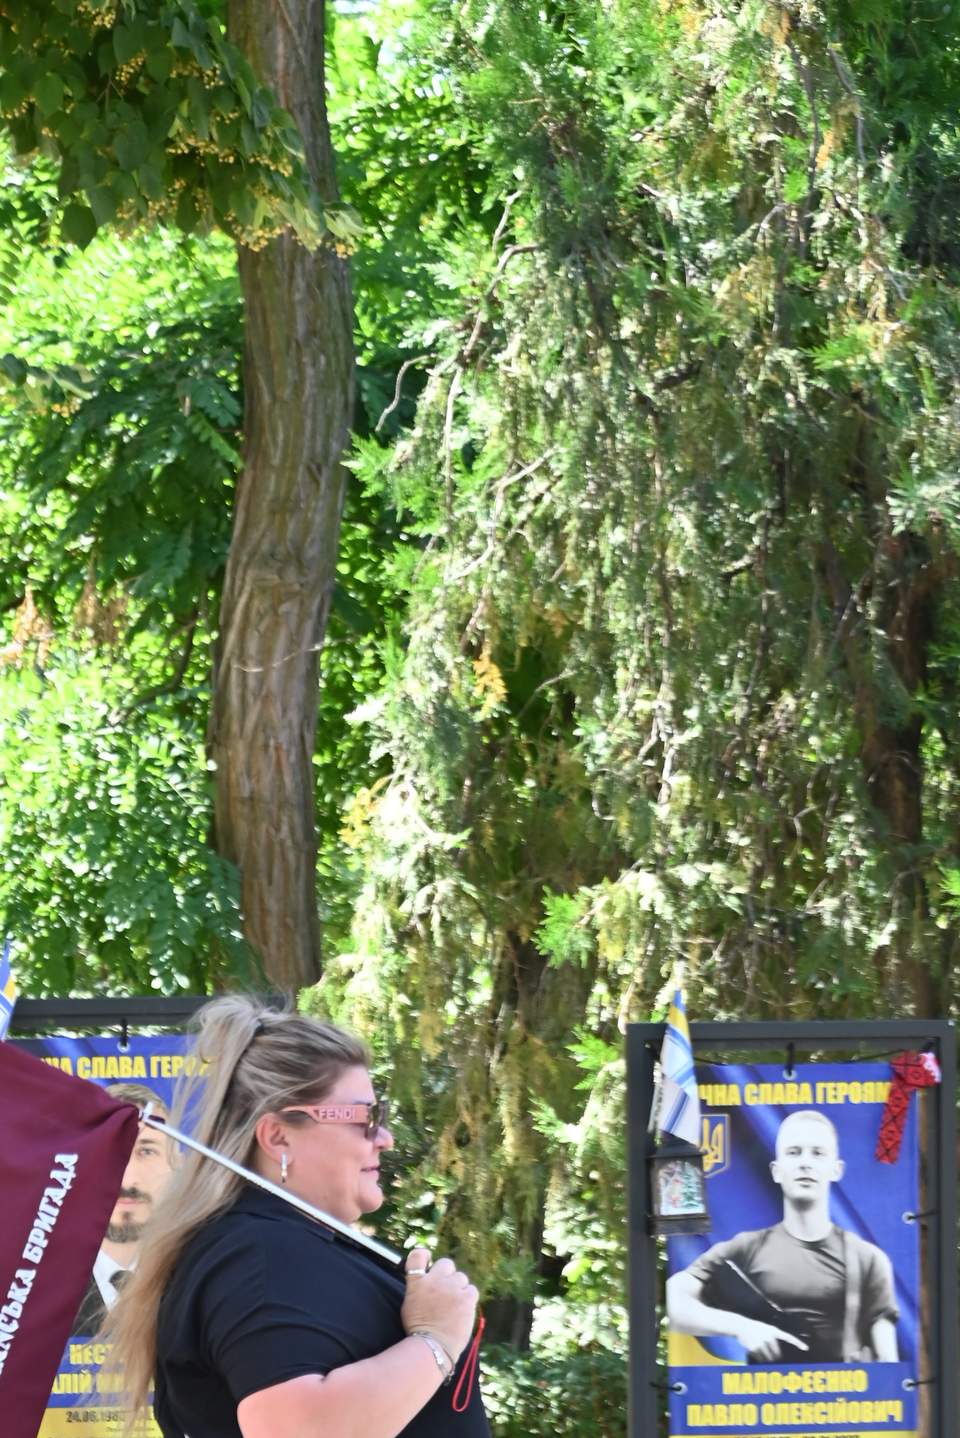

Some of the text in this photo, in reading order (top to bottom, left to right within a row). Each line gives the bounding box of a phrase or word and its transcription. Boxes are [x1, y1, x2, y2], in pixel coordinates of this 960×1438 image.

[76, 1056, 147, 1079] СЛАВА
[744, 1082, 814, 1106] СЛАВА
[319, 1108, 356, 1120] FENDI
[22, 1153, 79, 1264] БРИГАДА
[687, 1397, 903, 1427] ПАВЛО ОЛЕКСІЙОВИЧ
